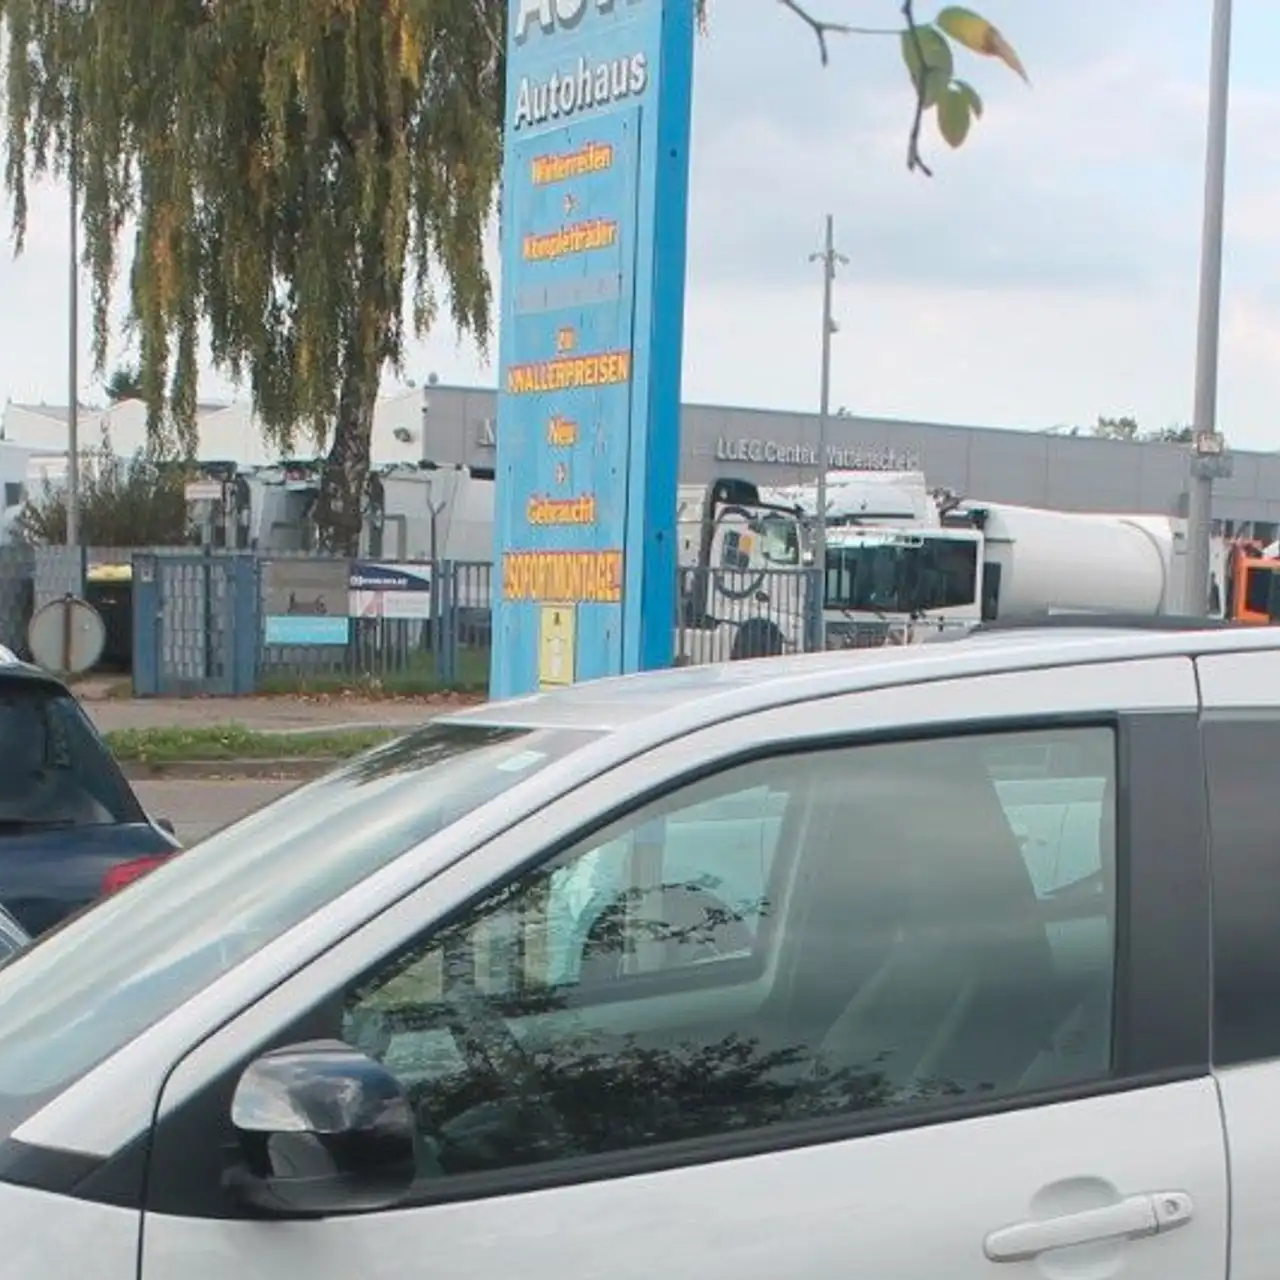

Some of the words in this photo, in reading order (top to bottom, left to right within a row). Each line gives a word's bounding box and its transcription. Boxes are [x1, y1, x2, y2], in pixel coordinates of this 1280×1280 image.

[515, 52, 646, 128] Autohaus
[548, 417, 577, 447] Neu
[527, 495, 595, 525] Gebraucht
